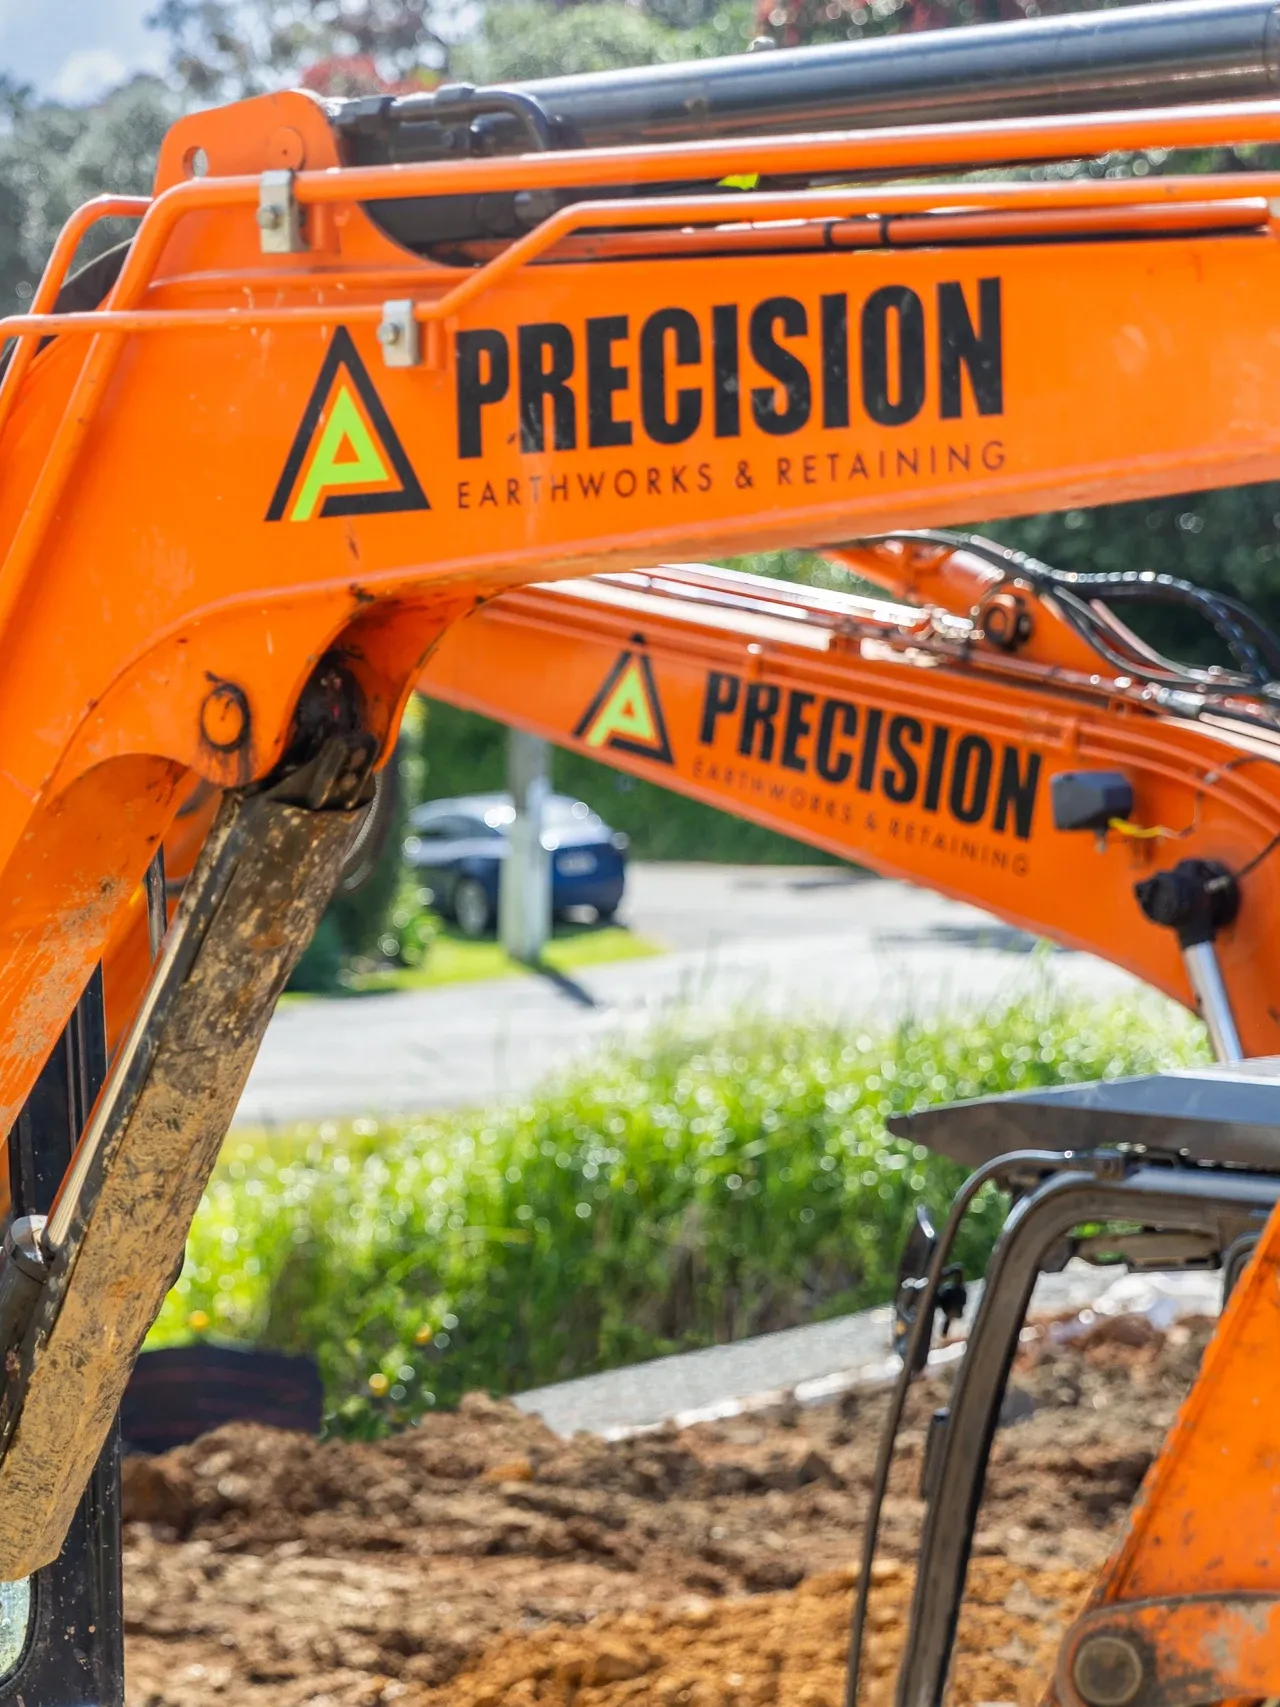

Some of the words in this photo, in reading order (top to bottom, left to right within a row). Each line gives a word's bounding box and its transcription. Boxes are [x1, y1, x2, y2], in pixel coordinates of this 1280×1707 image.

[455, 277, 1004, 460] PRECISION
[457, 462, 712, 510] EARTHWORKS
[737, 460, 754, 489] &
[778, 440, 1007, 486] RETAINING
[692, 755, 852, 825] EARTHWORKS
[888, 816, 1029, 878] RETAINING
[698, 671, 1042, 840] PRECISION
